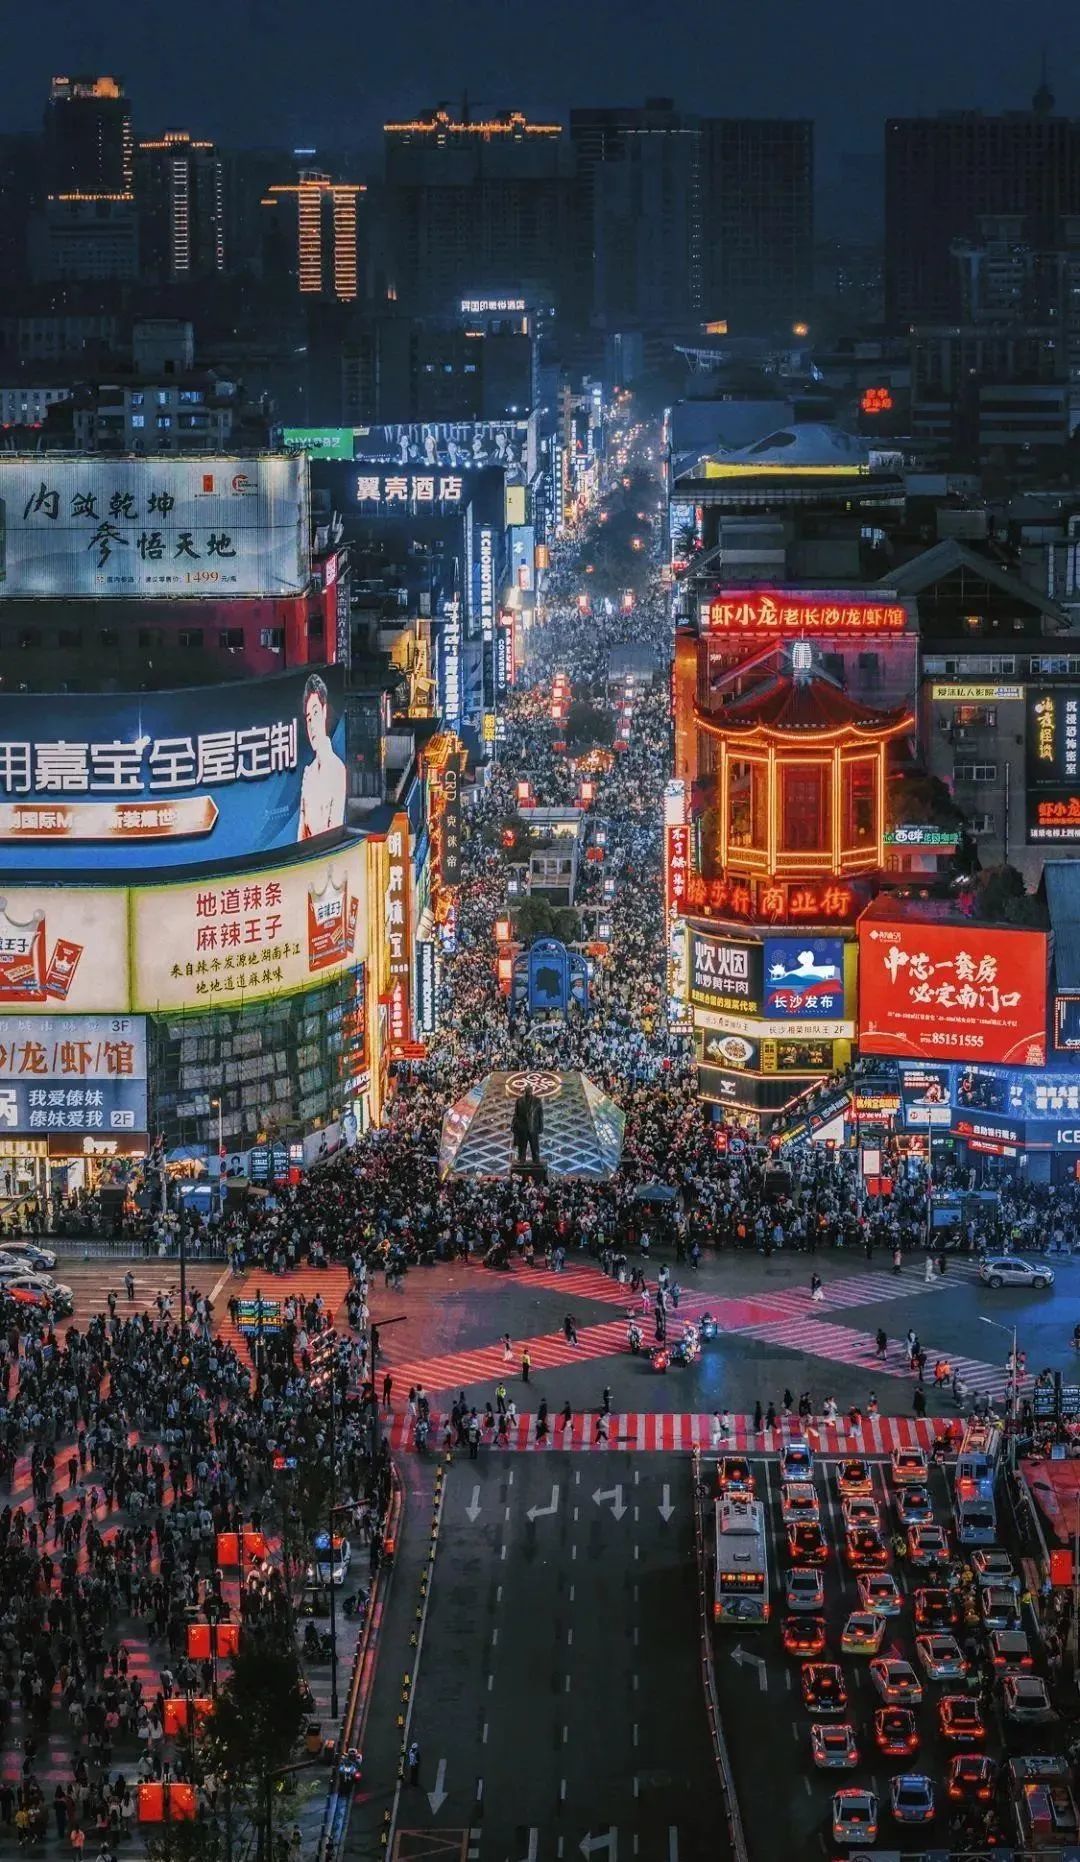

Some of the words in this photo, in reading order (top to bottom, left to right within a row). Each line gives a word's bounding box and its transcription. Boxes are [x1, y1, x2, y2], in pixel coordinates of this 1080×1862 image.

[357, 476, 463, 501] 翼壳酒店
[24, 482, 175, 520] 内敛乾坤
[185, 571, 219, 584] 1499
[445, 770, 457, 802] CRD
[196, 882, 283, 919] 地道辣条
[196, 914, 283, 953] 麻辣王子
[169, 942, 302, 979] 来自辣条发源地湖南平江
[196, 967, 284, 994] 地地道道麻辣味
[695, 972, 749, 995] 小炒黄牛肉
[774, 995, 834, 1009] 长沙发布
[909, 982, 1022, 1013] 必定南门口
[111, 1020, 130, 1032] 3F
[834, 1025, 845, 1035] 2F
[931, 1032, 984, 1048] 85151555
[0, 1040, 135, 1074] /龙/虾/馆
[28, 1089, 104, 1107] 我爱傣妹
[29, 1110, 104, 1128] 傣妹爱我
[113, 1113, 132, 1126] 2F
